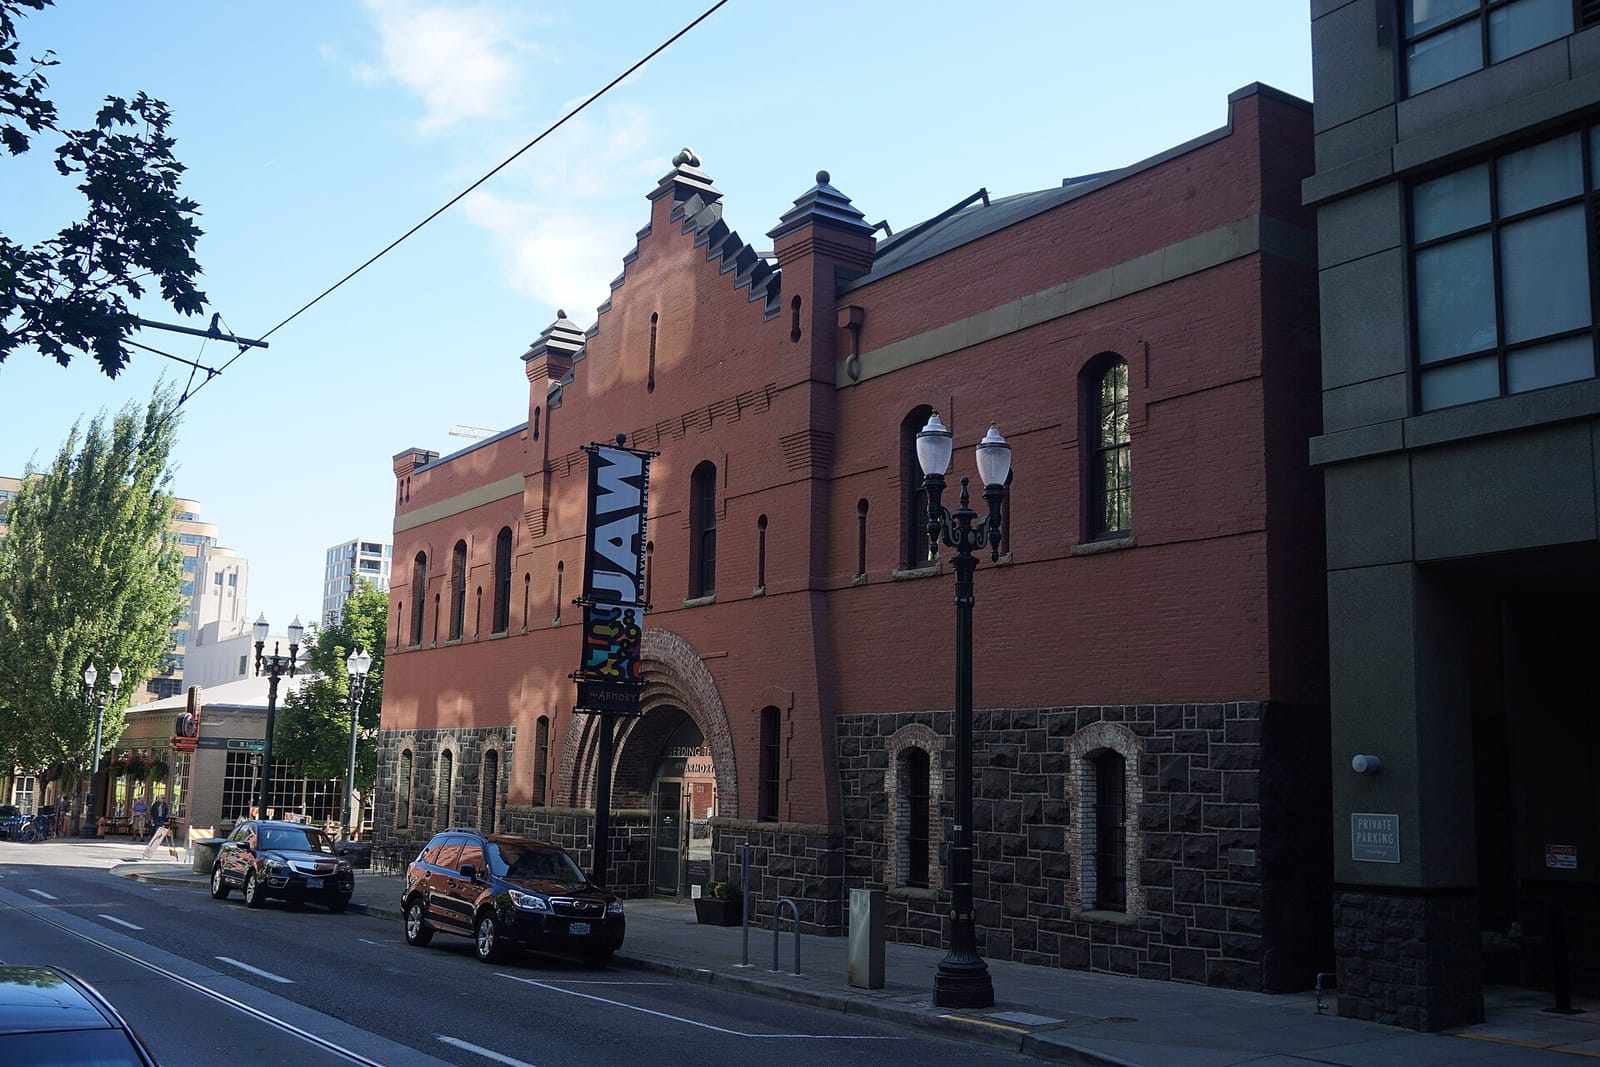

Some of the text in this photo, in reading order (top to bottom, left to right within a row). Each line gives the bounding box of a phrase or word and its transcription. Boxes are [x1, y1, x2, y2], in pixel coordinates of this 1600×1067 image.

[592, 447, 642, 604] JAW
[639, 513, 648, 589] PLAYWRIGHTS
[598, 690, 638, 703] ARMORY
[669, 746, 701, 757] ERDING
[685, 763, 715, 774] ARMORY
[1358, 818, 1393, 831] PRIVATE
[1356, 831, 1394, 845] PARKING
